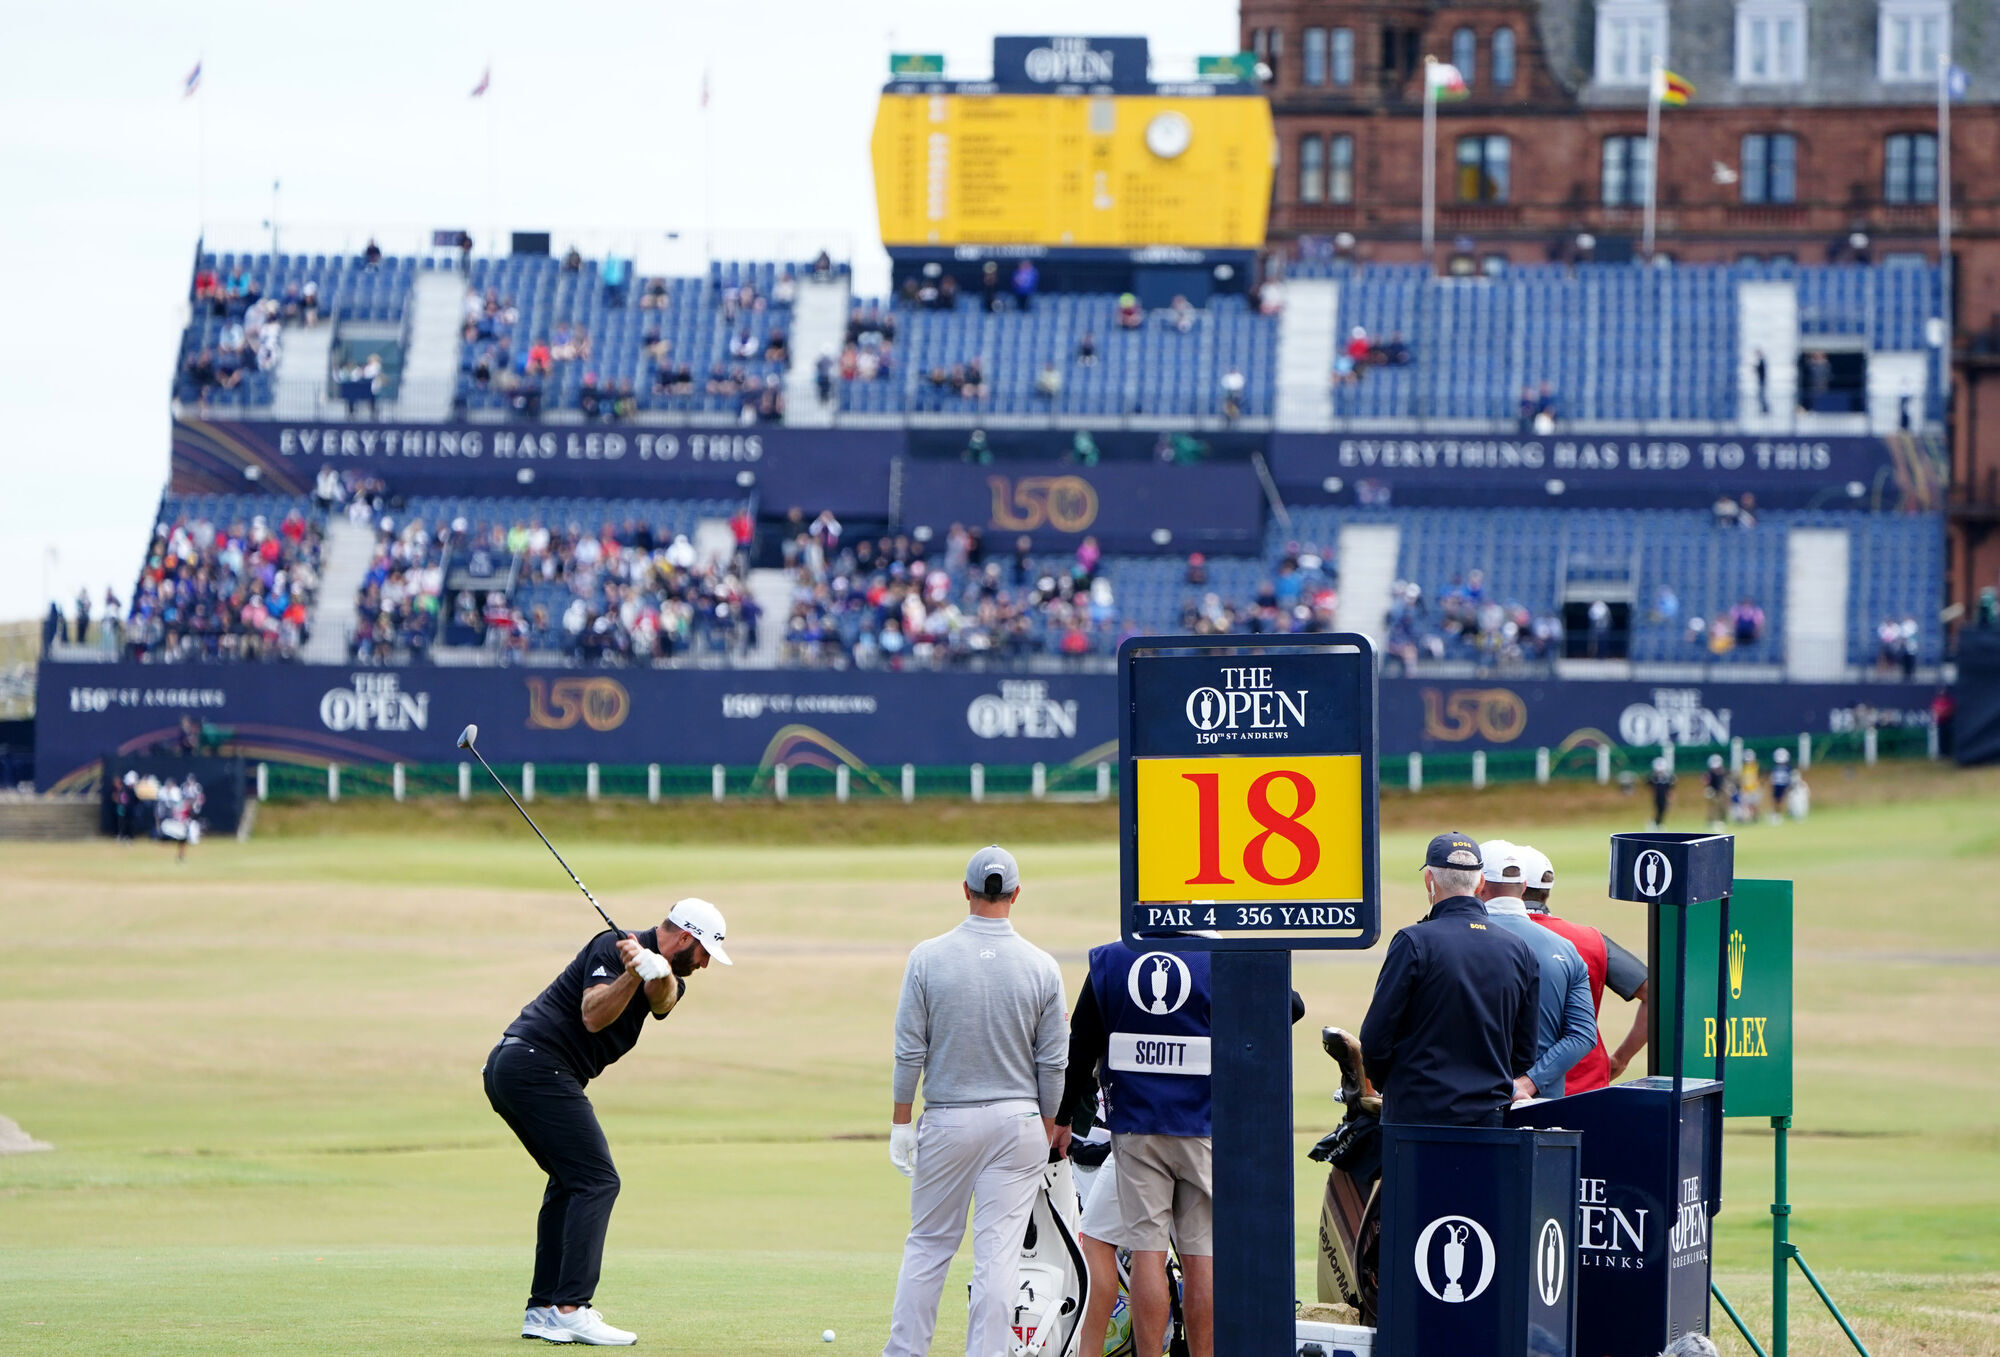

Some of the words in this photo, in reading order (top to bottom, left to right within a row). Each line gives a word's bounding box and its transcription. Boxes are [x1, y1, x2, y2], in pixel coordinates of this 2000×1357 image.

[280, 428, 483, 458] EVERYTHING
[494, 431, 557, 459] HAS
[567, 432, 627, 460] LED
[635, 433, 680, 461] TO
[688, 434, 763, 462] THIS
[1339, 440, 1545, 469] EVERYTHING
[1554, 441, 1619, 469] HAS
[1628, 442, 1691, 470] LED
[1699, 442, 1745, 470] TO
[1753, 442, 1830, 470] THIS
[987, 475, 1099, 533] 150
[352, 672, 399, 693] THE
[1220, 667, 1273, 690] THE
[320, 687, 429, 731] OPEN
[525, 676, 630, 732] 150
[967, 694, 1078, 738] OPEN
[1186, 686, 1309, 731] OPEN
[1420, 687, 1527, 743] 150
[1226, 733, 1238, 741] ST
[1240, 731, 1289, 741] ANDREWS
[1620, 702, 1732, 747] OPEN
[1181, 770, 1320, 886] 18
[1452, 841, 1472, 849] BOSS
[683, 920, 705, 936] TP5
[1148, 908, 1193, 927] PAR
[1203, 908, 1217, 926] 4
[1236, 907, 1273, 926] 356
[1279, 906, 1356, 926] YARDS
[1470, 923, 1487, 931] BOSS
[1135, 1039, 1187, 1067] SCOTT
[1683, 1176, 1699, 1203] THE
[1578, 1205, 1649, 1253] EN
[1671, 1200, 1708, 1253] OPEN
[1672, 1249, 1706, 1269] GREENLINKS
